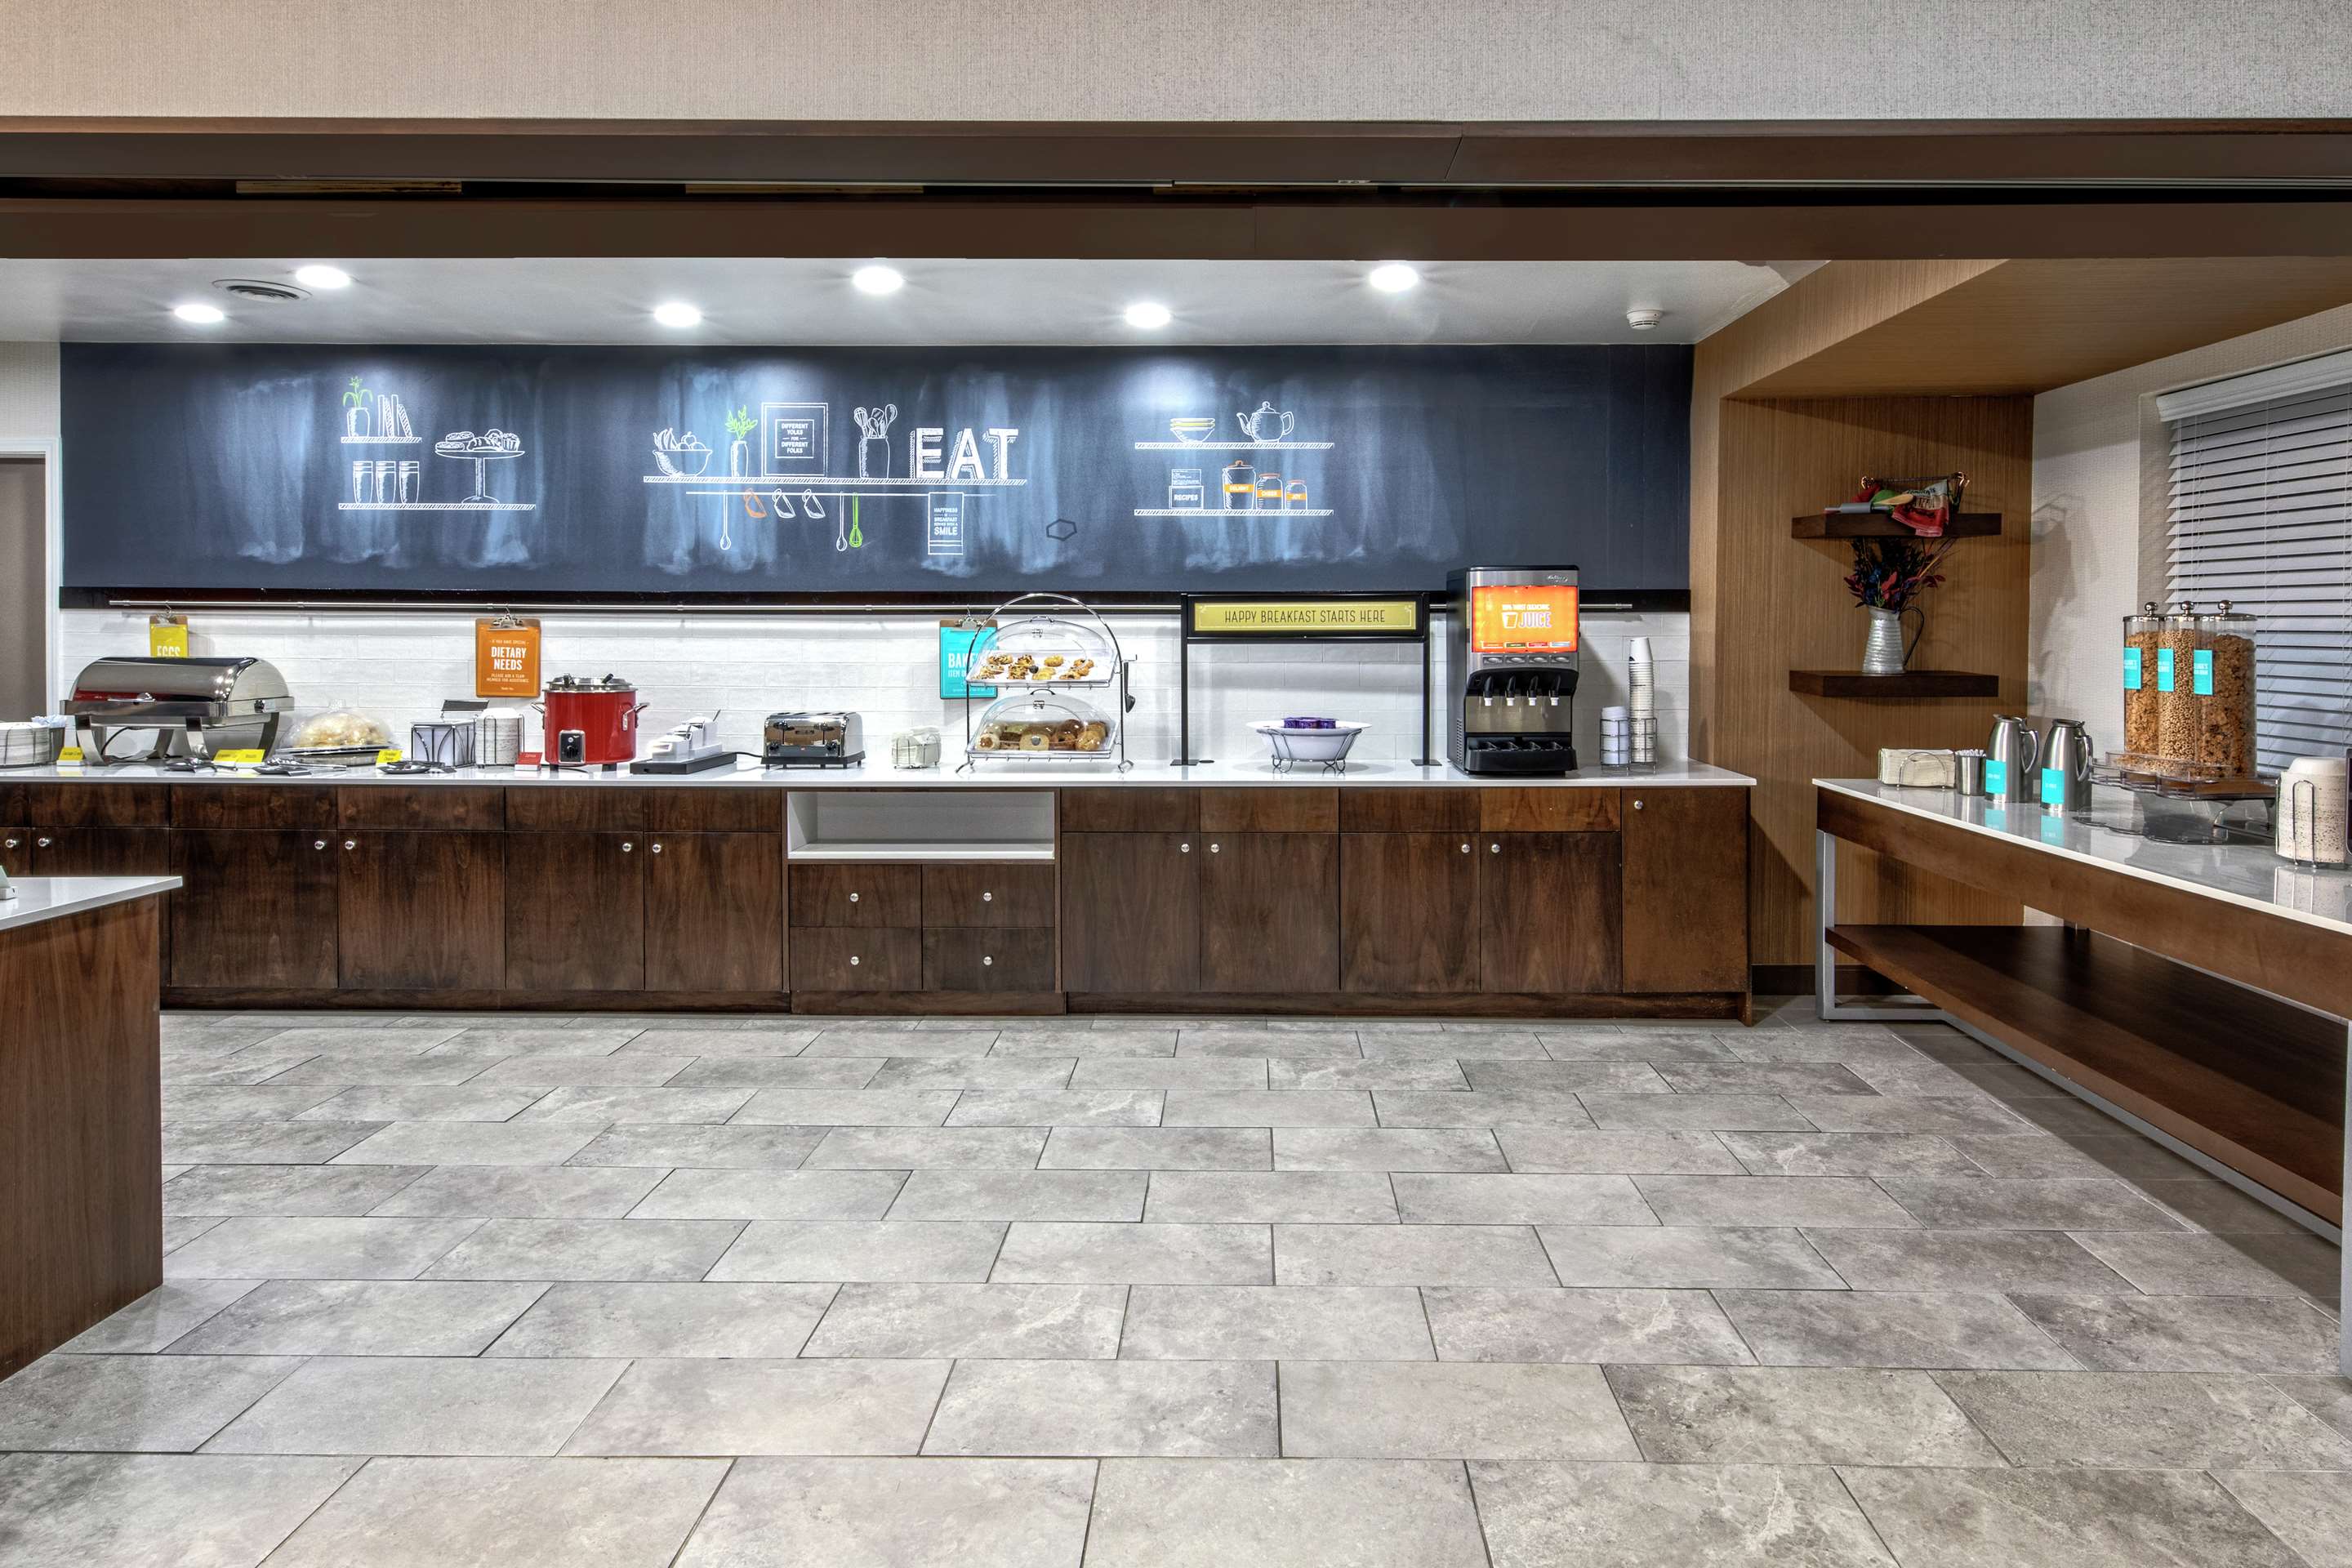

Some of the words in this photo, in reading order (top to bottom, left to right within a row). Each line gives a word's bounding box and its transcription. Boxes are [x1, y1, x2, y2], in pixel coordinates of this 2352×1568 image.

[909, 427, 1018, 479] EAT
[933, 527, 958, 536] SMILE
[1224, 610, 1257, 623] HAPPY
[1261, 610, 1316, 623] BREAKFAST
[1320, 609, 1356, 622] STARTS
[1360, 609, 1386, 622] HERE
[1519, 611, 1552, 629] JUICE
[157, 645, 181, 658] EGGS
[491, 646, 527, 658] DIETARY
[493, 658, 523, 670] NEEDS
